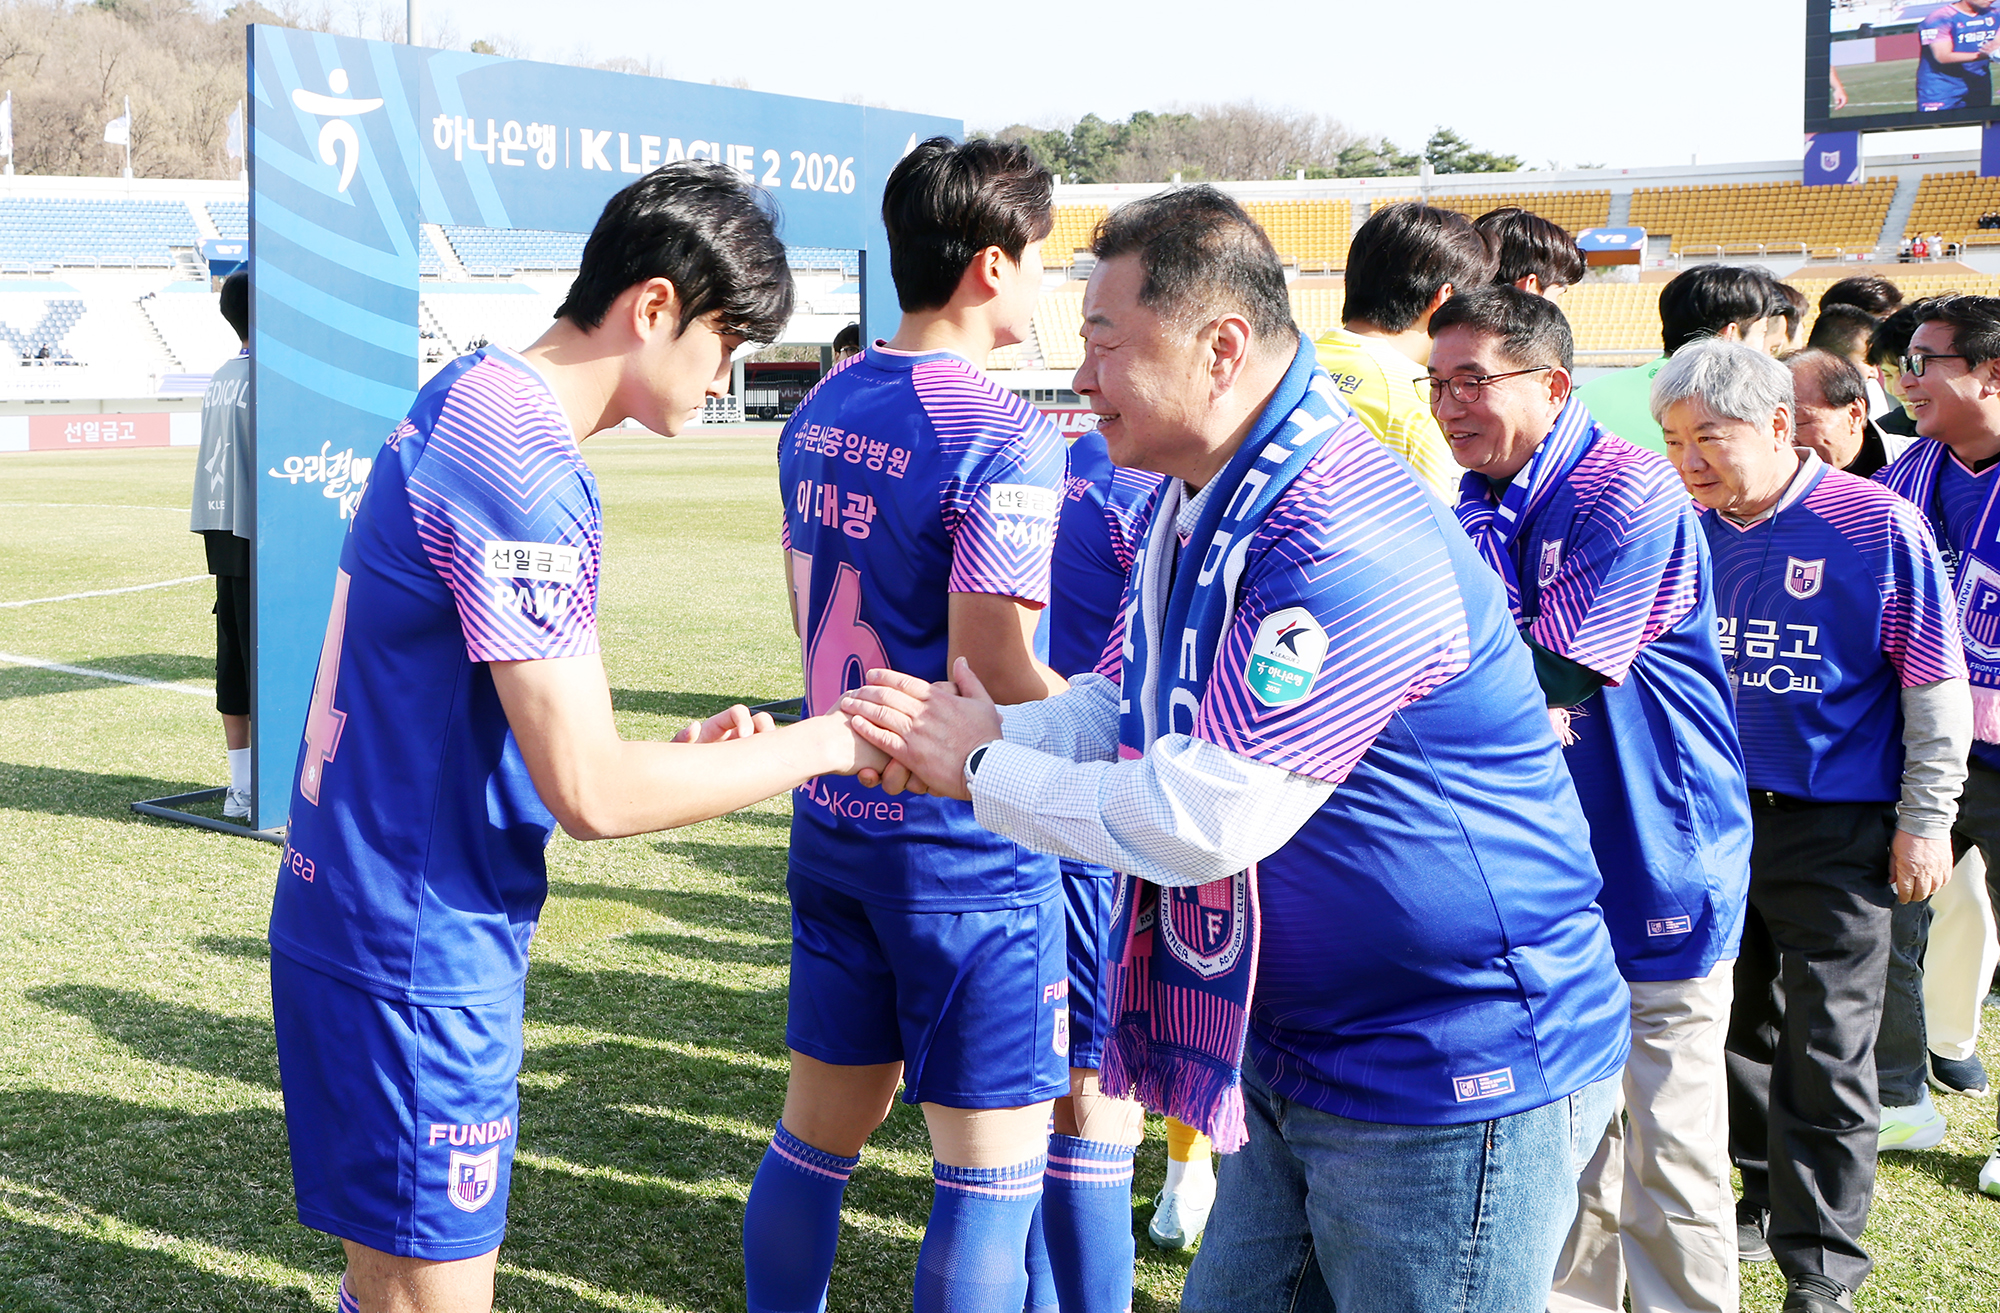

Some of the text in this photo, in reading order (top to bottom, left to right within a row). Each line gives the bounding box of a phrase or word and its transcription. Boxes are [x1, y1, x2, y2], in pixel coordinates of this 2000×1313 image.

[432, 113, 557, 170] 하나은행
[579, 128, 613, 172] K
[761, 149, 782, 187] 2
[790, 150, 856, 195] 2026
[203, 379, 250, 410] EDICAL
[63, 421, 137, 443] 선일금고
[804, 424, 912, 480] 문산중앙병원
[796, 479, 878, 540] 이대광
[491, 549, 573, 574] 선일금고
[494, 585, 569, 620] PAJU
[832, 791, 904, 821] Korea
[428, 1115, 512, 1147] FUNDA
